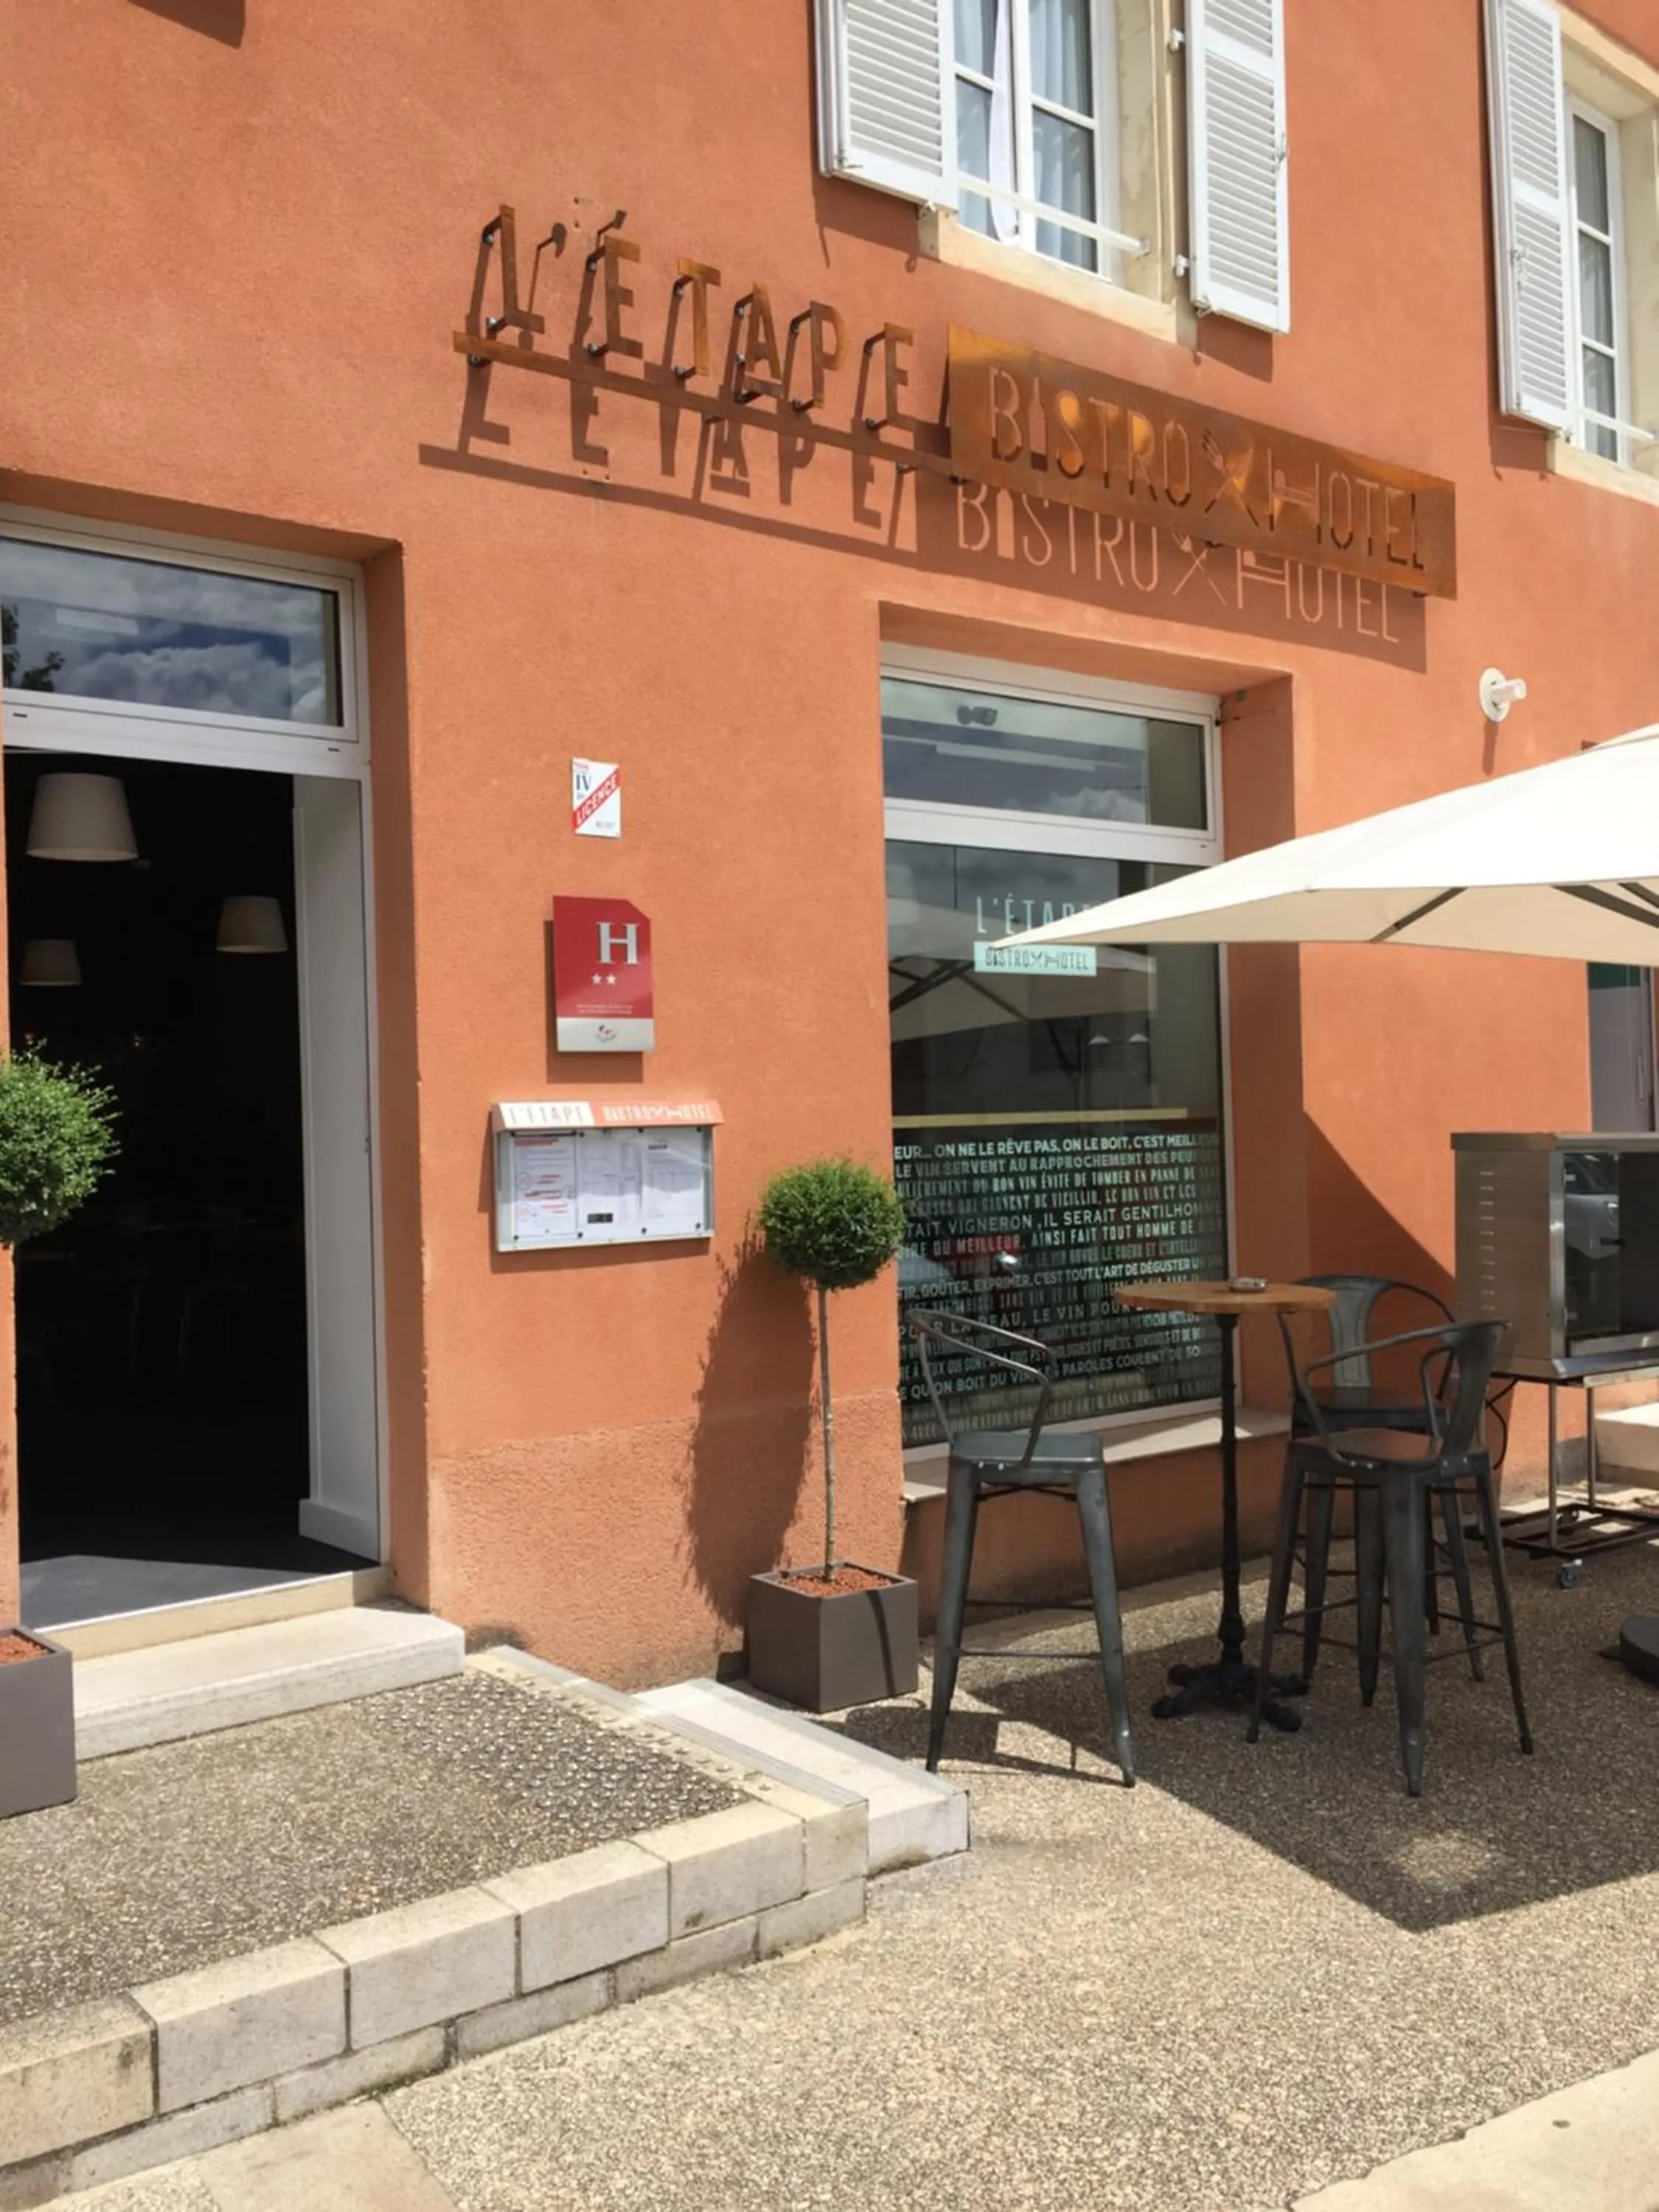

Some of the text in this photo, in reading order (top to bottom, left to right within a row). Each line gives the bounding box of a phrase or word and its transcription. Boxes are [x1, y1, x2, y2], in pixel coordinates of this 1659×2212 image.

[990, 367, 1425, 571] BISTRO HOTEL
[977, 892, 1091, 934] L'ÉTAP
[597, 922, 640, 964] H
[985, 947, 1030, 968] BISTRO
[934, 1143, 954, 1157] ON
[958, 1142, 975, 1155] NE
[978, 1141, 993, 1155] LE
[998, 1138, 1031, 1154] RÊVE
[1062, 1138, 1080, 1150] ON
[1082, 1137, 1097, 1150] LE
[1133, 1134, 1164, 1148] C'EST
[896, 1164, 910, 1178] LE
[943, 1159, 1004, 1175] SERVENT
[1009, 1158, 1026, 1171] AU
[1030, 1152, 1142, 1170] RAPPROCHEMENT
[1145, 1150, 1168, 1165] DES
[1063, 1207, 1116, 1225] SERAIT
[1031, 1229, 1065, 1248] AINSI
[1070, 1226, 1096, 1244] FAIT
[1102, 1225, 1131, 1242] TOUT
[1135, 1221, 1176, 1238] HOMME
[1034, 1270, 1062, 1285] C'EST
[1065, 1267, 1093, 1282] TOUT
[1094, 1264, 1124, 1279] L'ART
[1124, 1262, 1138, 1276] DE
[1139, 1255, 1190, 1274] DÉGUSTER
[1032, 1307, 1050, 1324] LE
[1056, 1302, 1084, 1321] VIN
[911, 1381, 951, 1399] QUON
[990, 1373, 1006, 1387] DU
[1062, 1357, 1112, 1377] PAROLES
